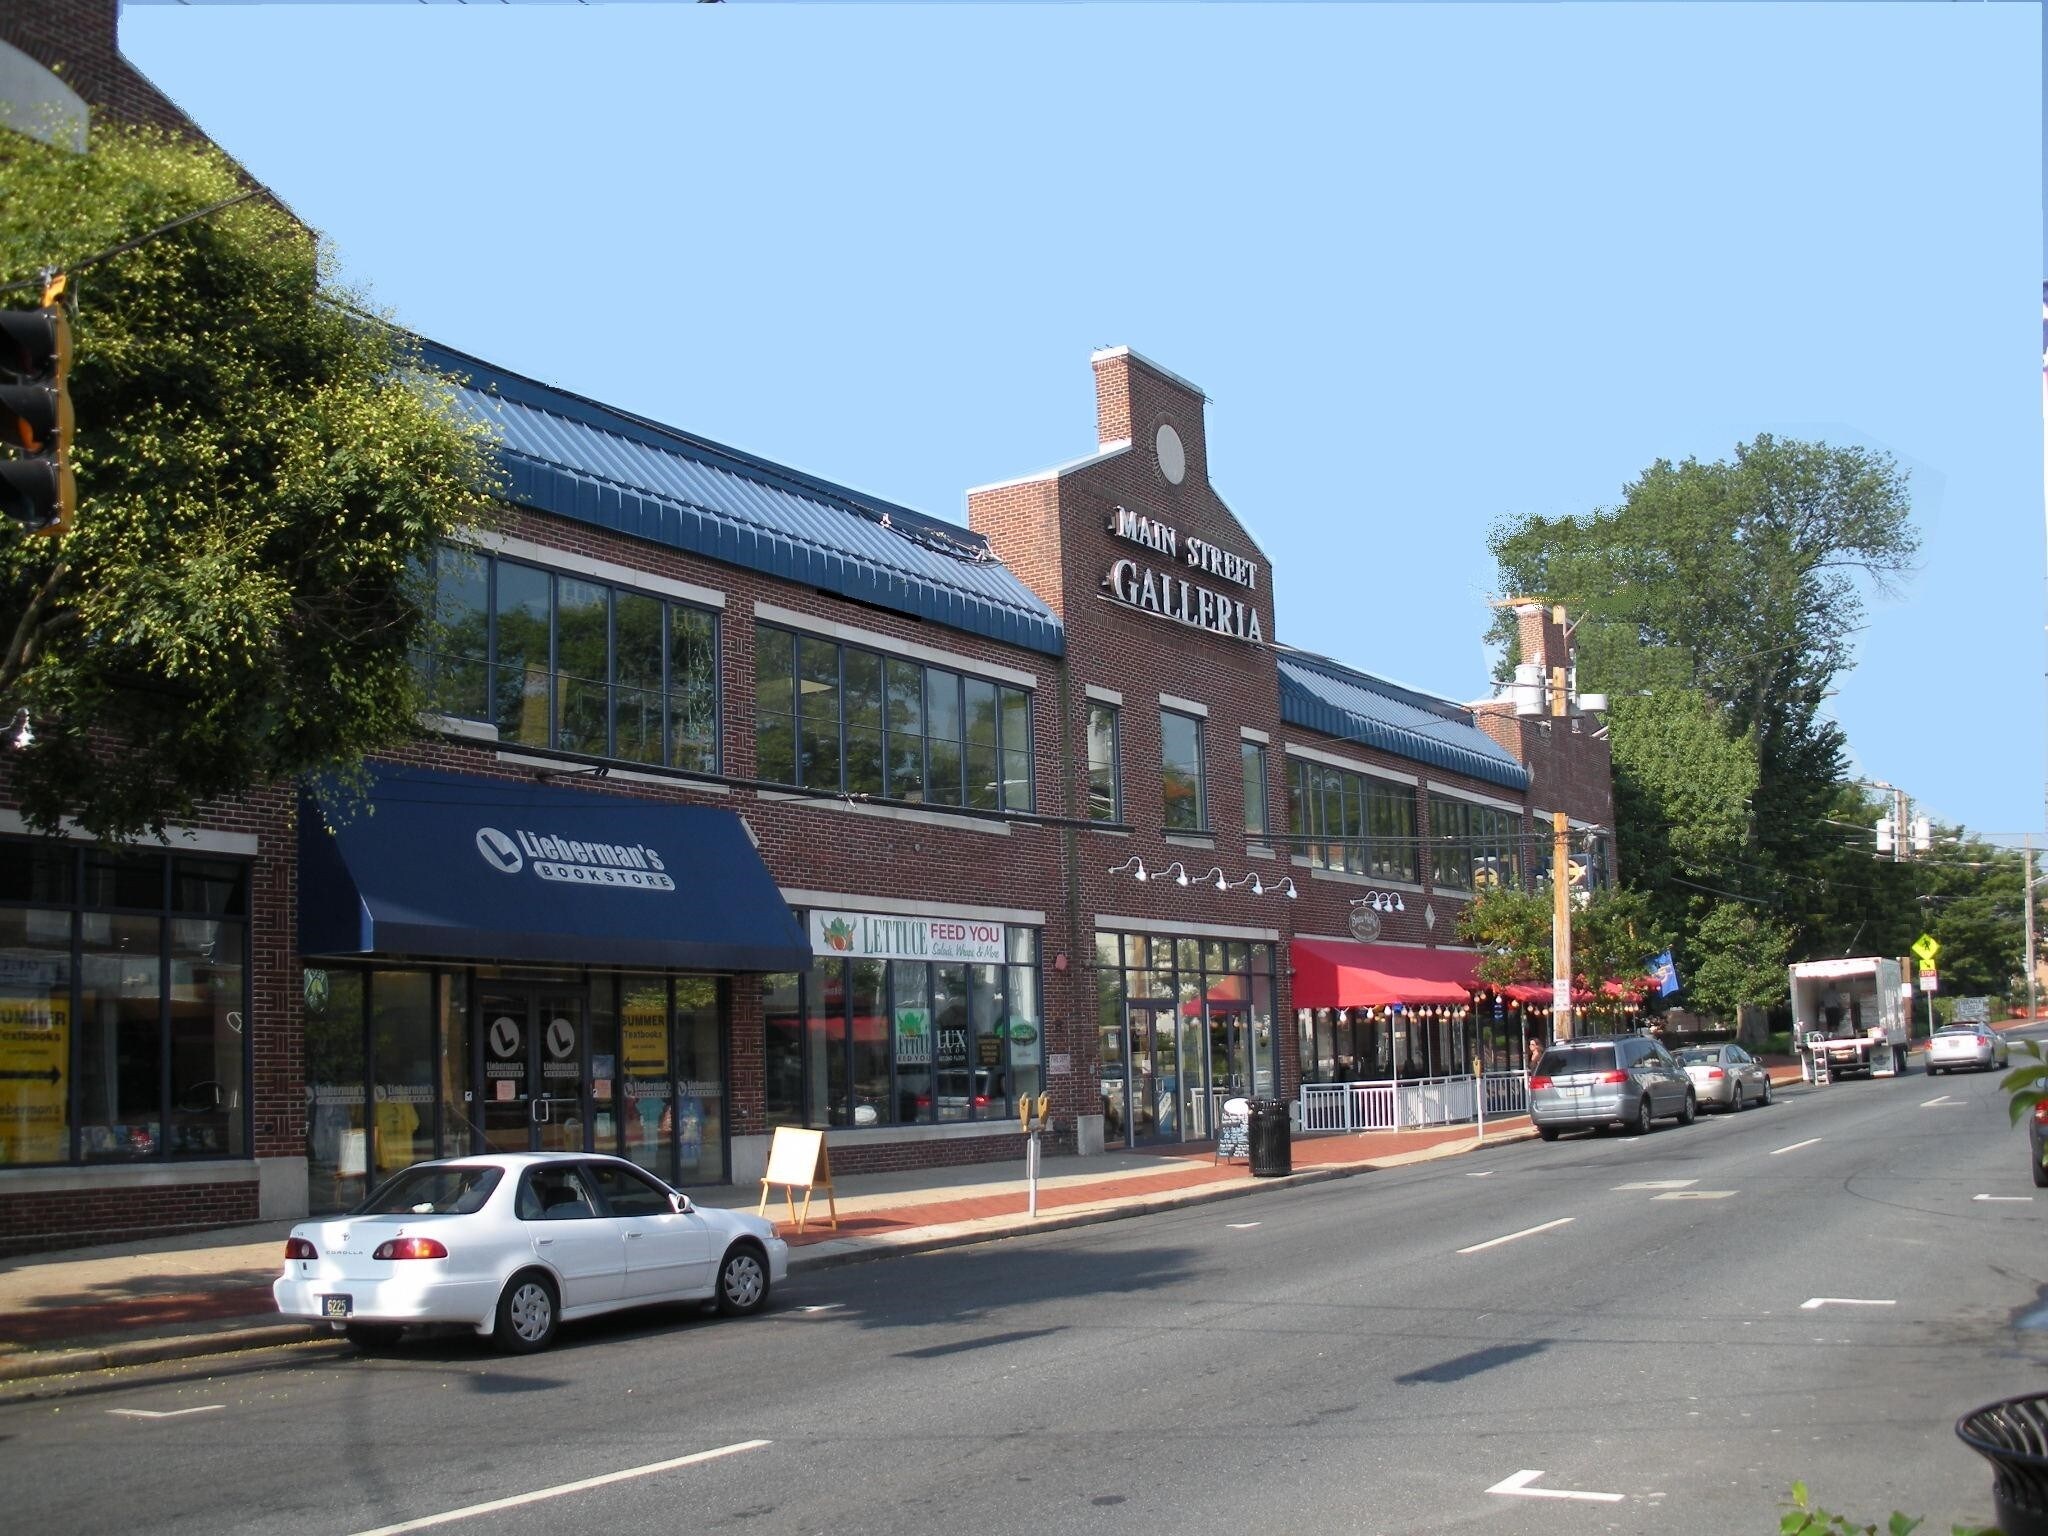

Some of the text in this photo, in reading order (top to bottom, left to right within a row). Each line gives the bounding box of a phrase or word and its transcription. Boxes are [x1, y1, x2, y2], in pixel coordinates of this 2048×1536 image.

[1114, 505, 1258, 589] MAIN STREET
[1111, 559, 1263, 642] GALLERIA
[516, 829, 665, 871] Lieberman's
[541, 864, 670, 888] BOOKSTORE
[863, 916, 928, 955] LETTUCE
[931, 923, 1000, 943] FEED YOU
[622, 1015, 665, 1027] SUMMER
[0, 1031, 61, 1041] extbooks
[623, 1030, 663, 1041] Textbooks
[936, 1029, 967, 1049] LUX
[327, 1299, 347, 1313] 6225
